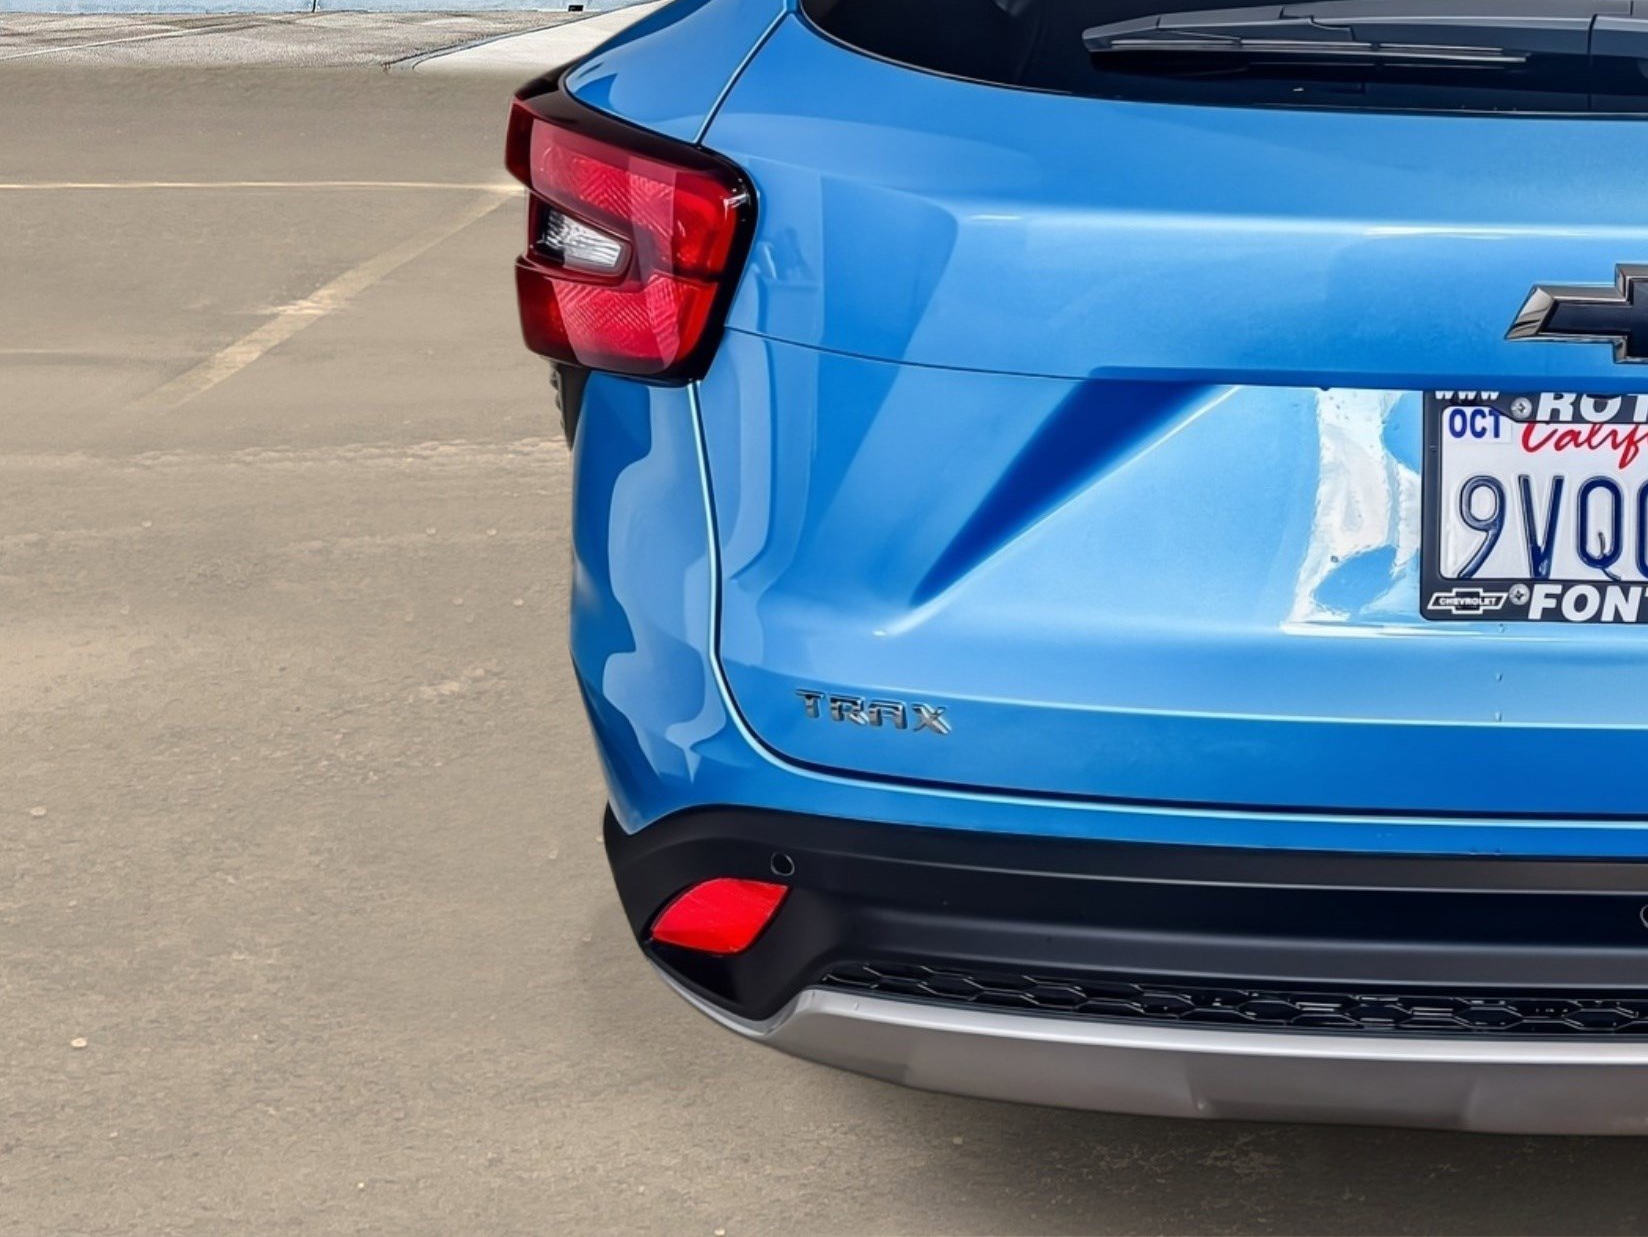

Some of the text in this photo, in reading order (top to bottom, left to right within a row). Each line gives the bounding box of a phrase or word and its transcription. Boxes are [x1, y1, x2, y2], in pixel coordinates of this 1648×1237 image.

[1449, 406, 1501, 439] OCT
[1439, 597, 1497, 606] CHEVROLET
[795, 689, 951, 734] TRAX
